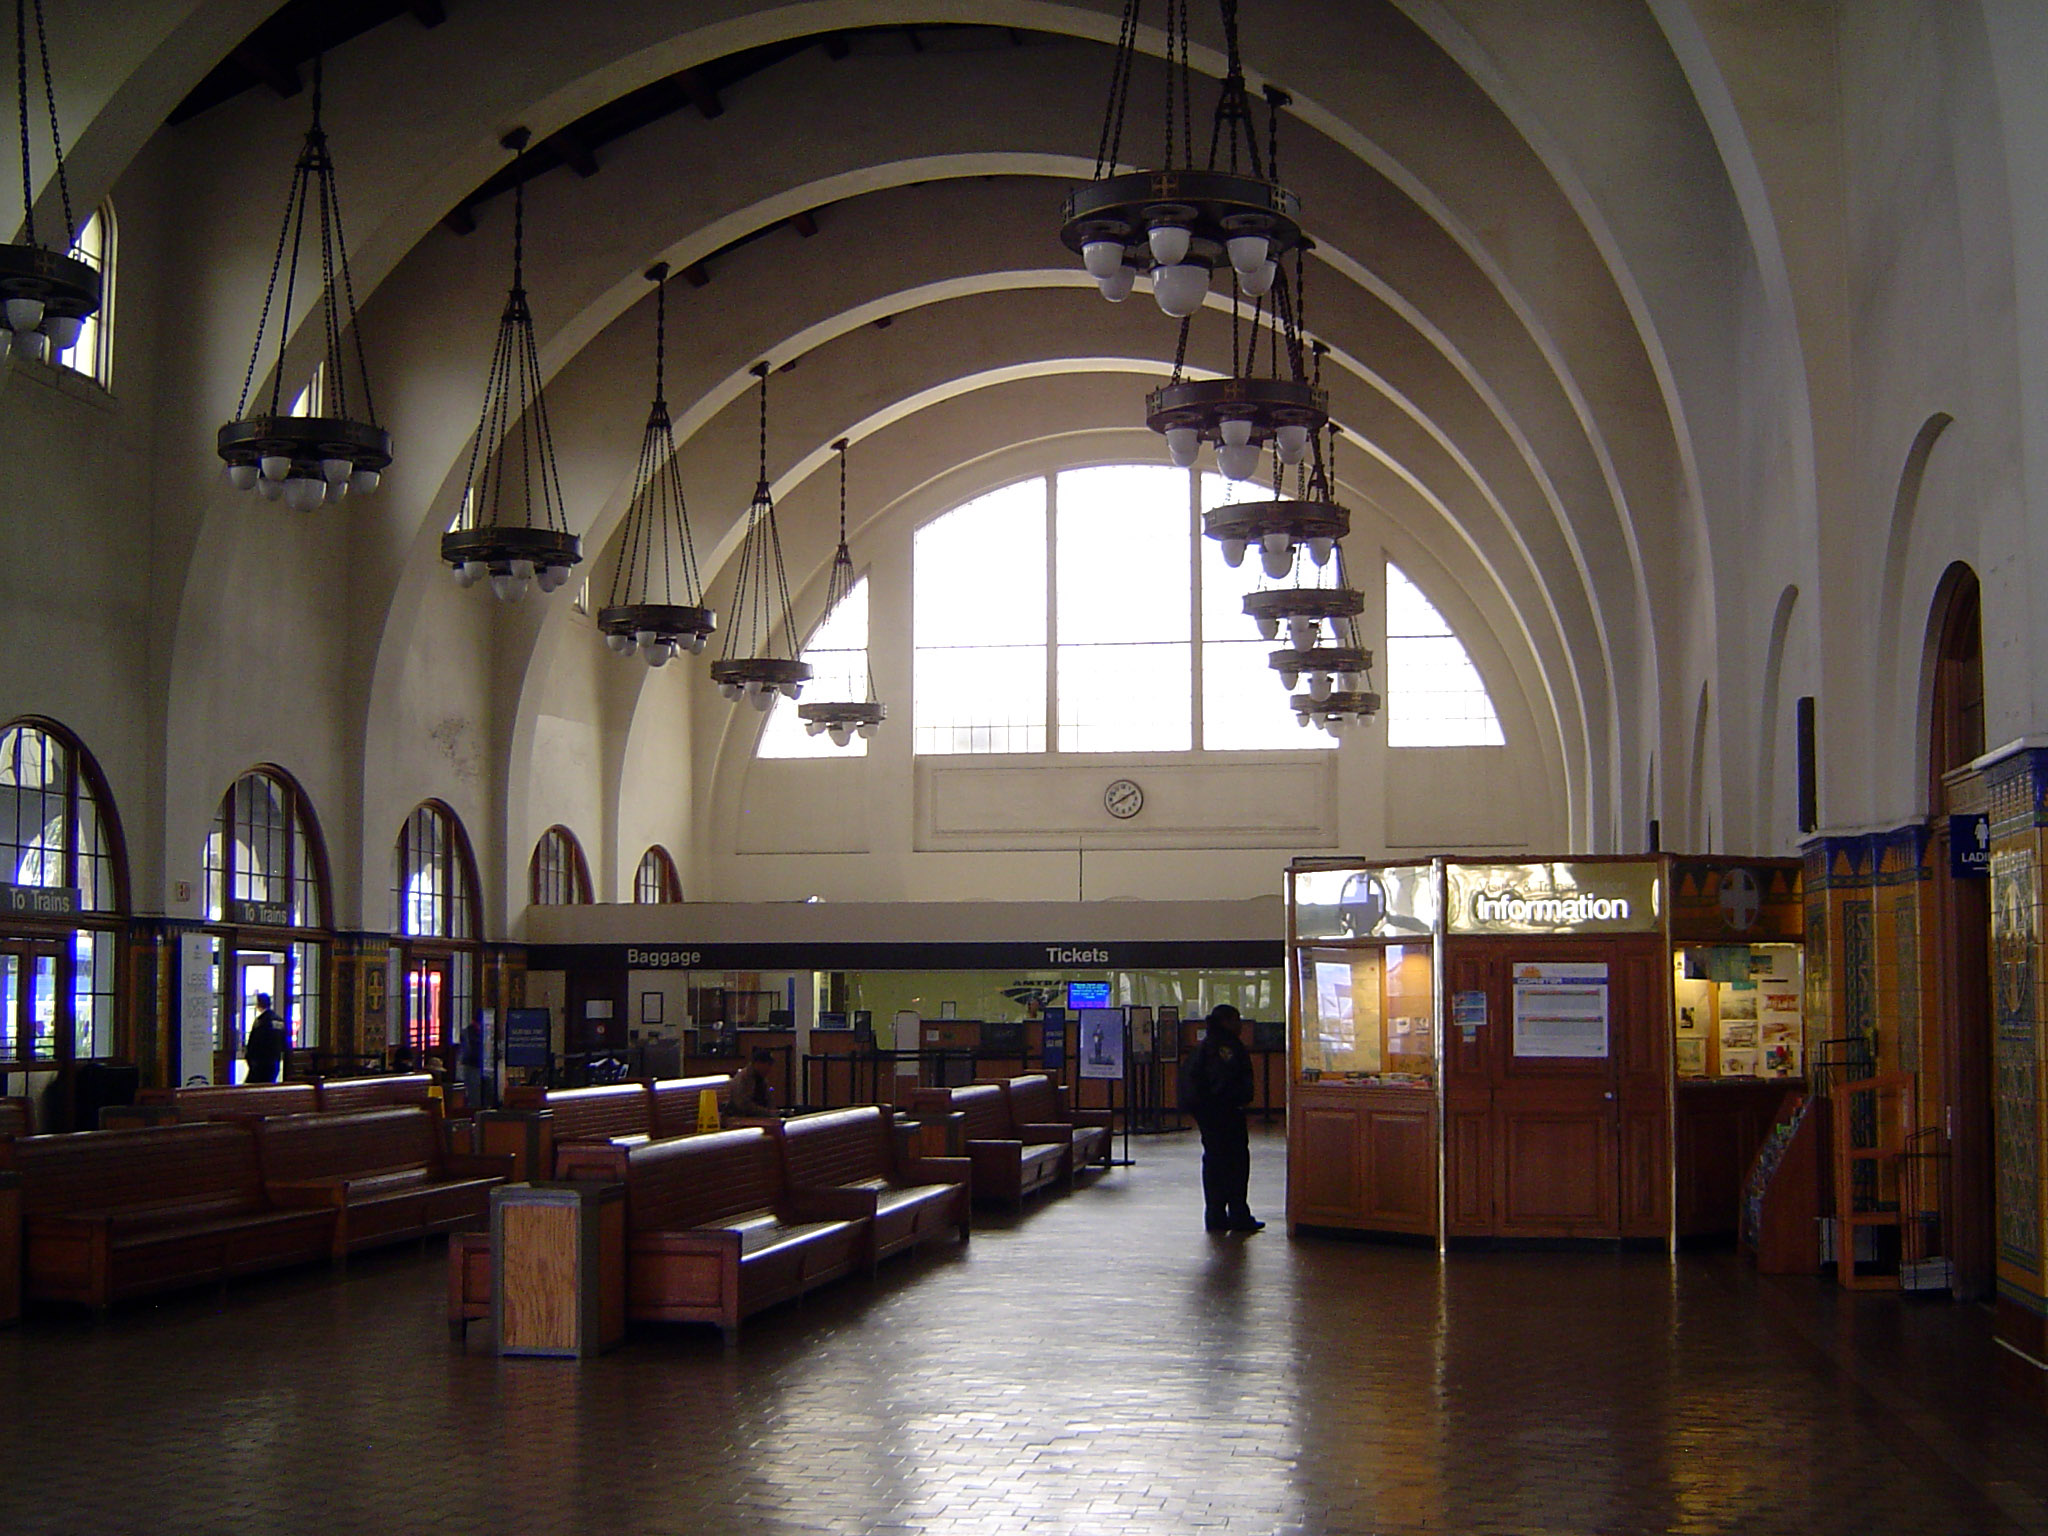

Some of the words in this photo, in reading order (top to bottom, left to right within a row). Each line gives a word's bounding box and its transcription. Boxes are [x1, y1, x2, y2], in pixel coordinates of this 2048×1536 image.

[1961, 851, 1989, 863] LADI
[9, 888, 25, 910] To
[31, 890, 70, 912] Trains
[1476, 892, 1629, 920] Information
[243, 902, 255, 922] To
[258, 904, 287, 924] Trains
[627, 948, 701, 966] Baggage
[1046, 947, 1109, 963] Tickets
